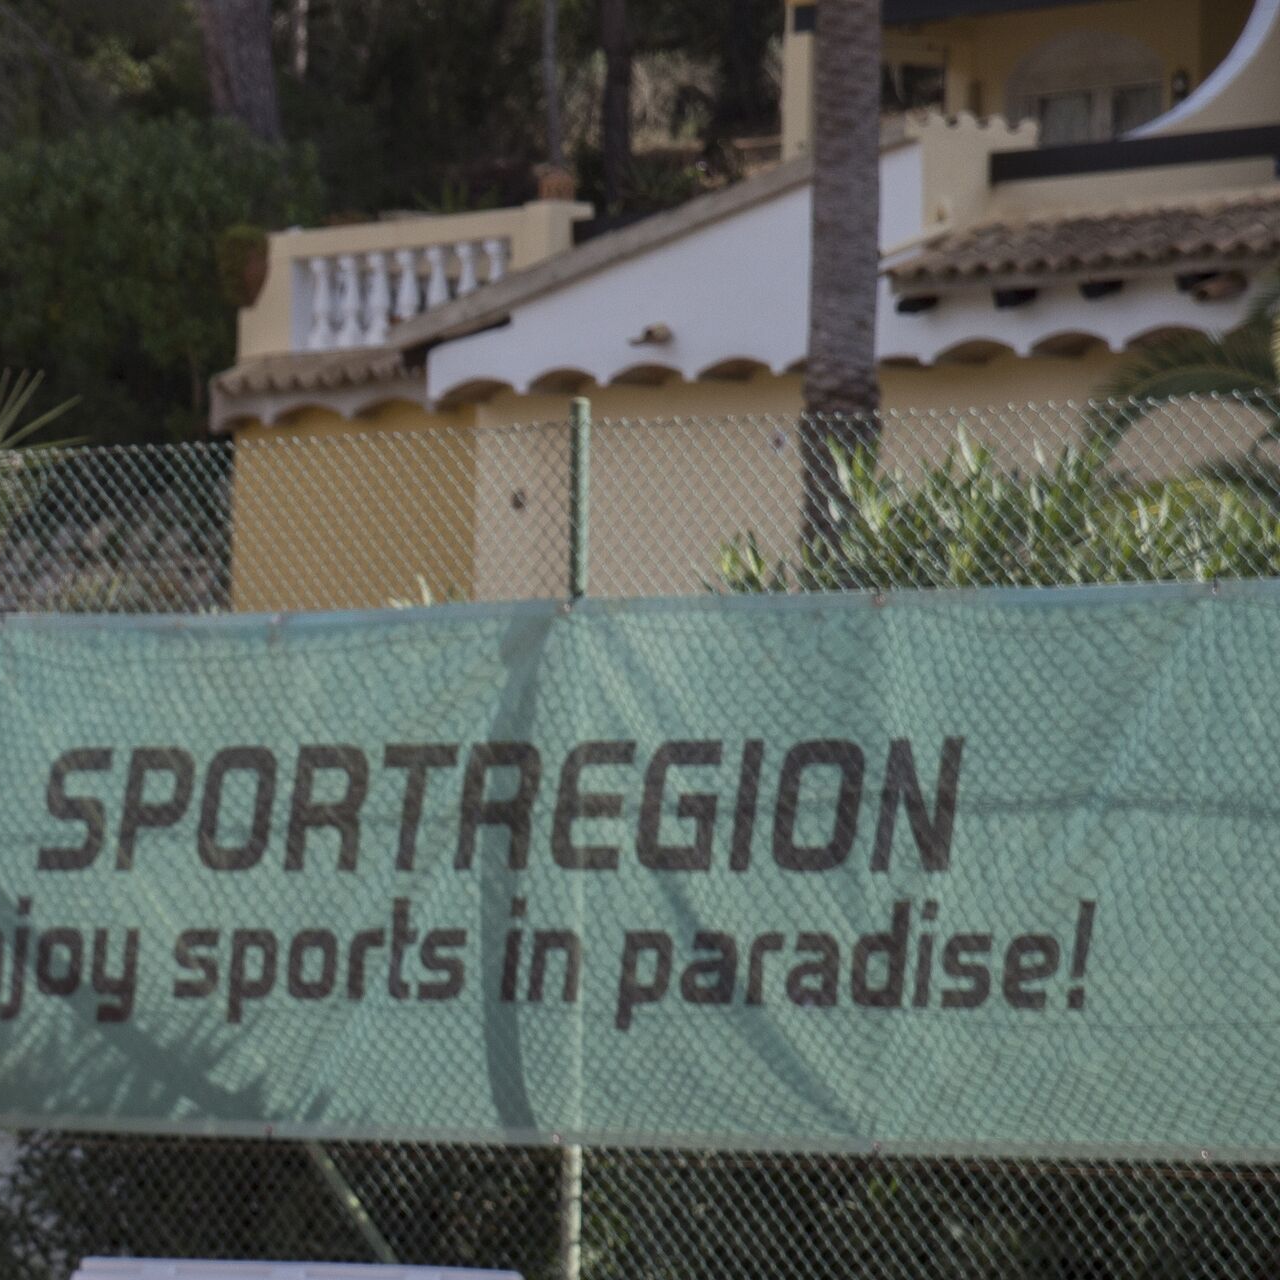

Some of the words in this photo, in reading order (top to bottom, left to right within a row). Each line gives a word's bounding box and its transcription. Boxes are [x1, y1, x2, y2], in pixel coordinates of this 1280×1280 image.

[38, 737, 965, 872] SPORTREGION
[173, 897, 468, 1023] sports
[502, 896, 580, 1001] in
[614, 898, 1097, 1031] paradise!
